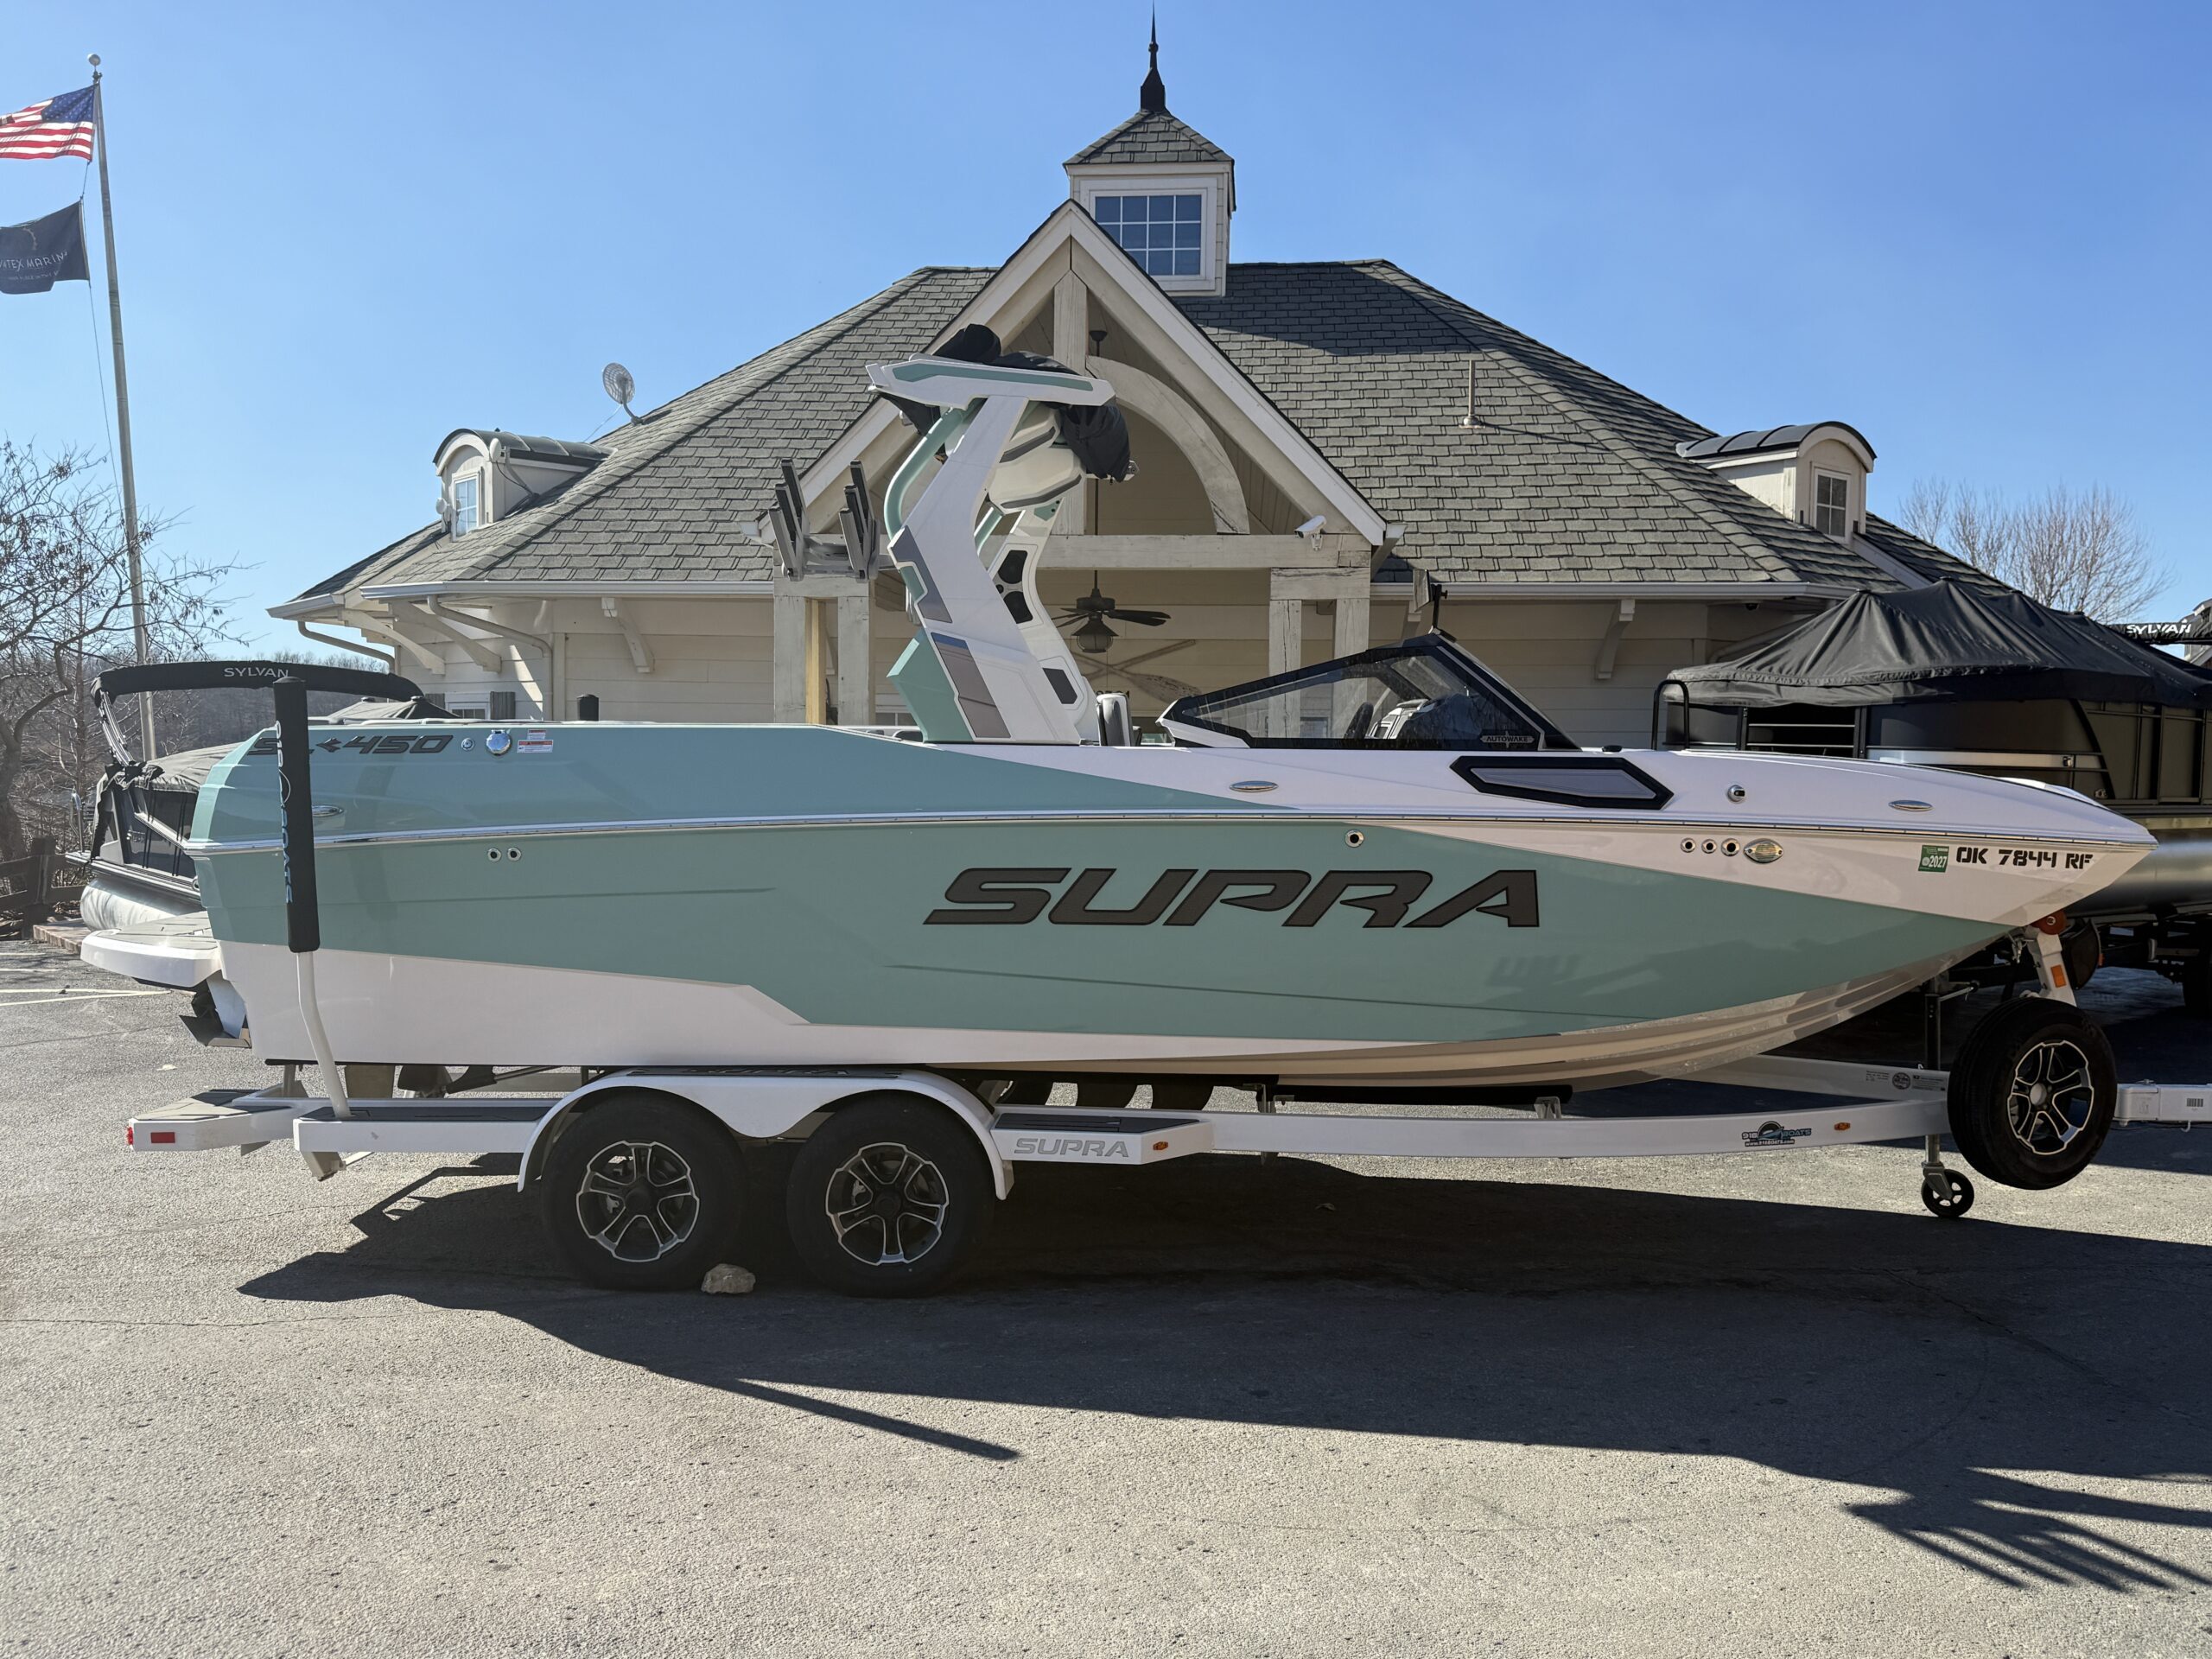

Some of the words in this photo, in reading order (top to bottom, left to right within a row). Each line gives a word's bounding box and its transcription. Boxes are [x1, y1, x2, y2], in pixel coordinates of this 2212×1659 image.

[2126, 623, 2192, 635] SYLVAN
[223, 666, 289, 678] SYLVAN
[342, 734, 454, 754] 450
[1928, 855, 1948, 868] 2027
[1955, 846, 1989, 864] OK
[1999, 849, 2057, 868] 7844
[2065, 853, 2094, 869] RF
[923, 868, 1540, 929] SUPRA
[1783, 1128, 1812, 1137] BOATS
[1014, 1137, 1129, 1158] SUPRA
